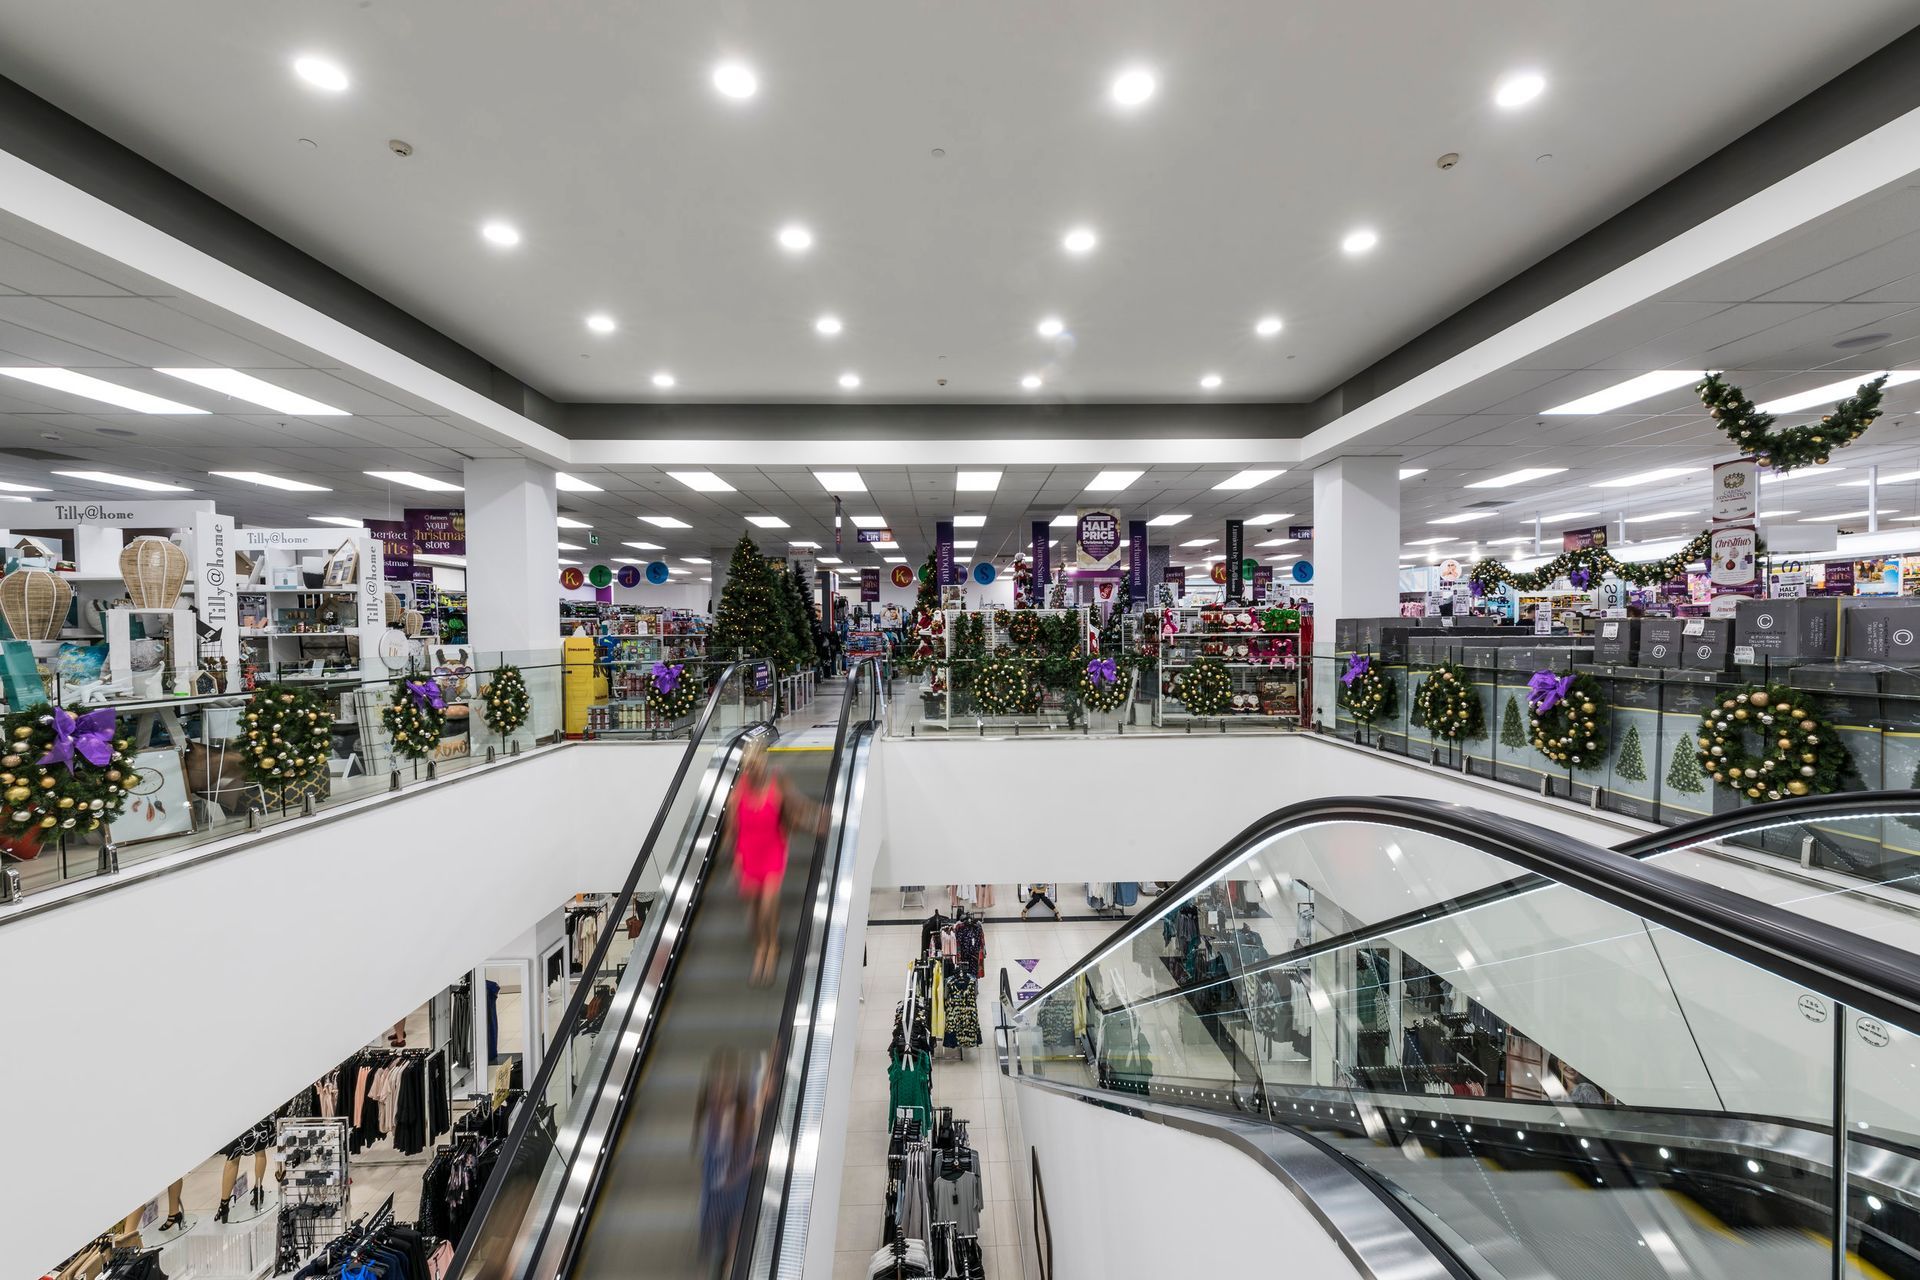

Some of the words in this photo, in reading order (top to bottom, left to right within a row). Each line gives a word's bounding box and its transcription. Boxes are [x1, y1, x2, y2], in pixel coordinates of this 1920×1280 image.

[55, 505, 134, 524] Tilly@home
[425, 523, 449, 531] your
[1082, 521, 1115, 531] HALF
[247, 531, 309, 545] Tilly@home
[414, 529, 465, 541] hristmas
[866, 534, 880, 542] Lift
[1082, 531, 1115, 540] PRICE
[1297, 531, 1310, 539] Lift
[383, 542, 409, 555] ifts
[425, 541, 450, 549] store
[1714, 538, 1752, 548] Christmas
[940, 542, 951, 583] Baroque
[206, 523, 234, 624] Tilly@home
[365, 546, 383, 625] Tilly@home
